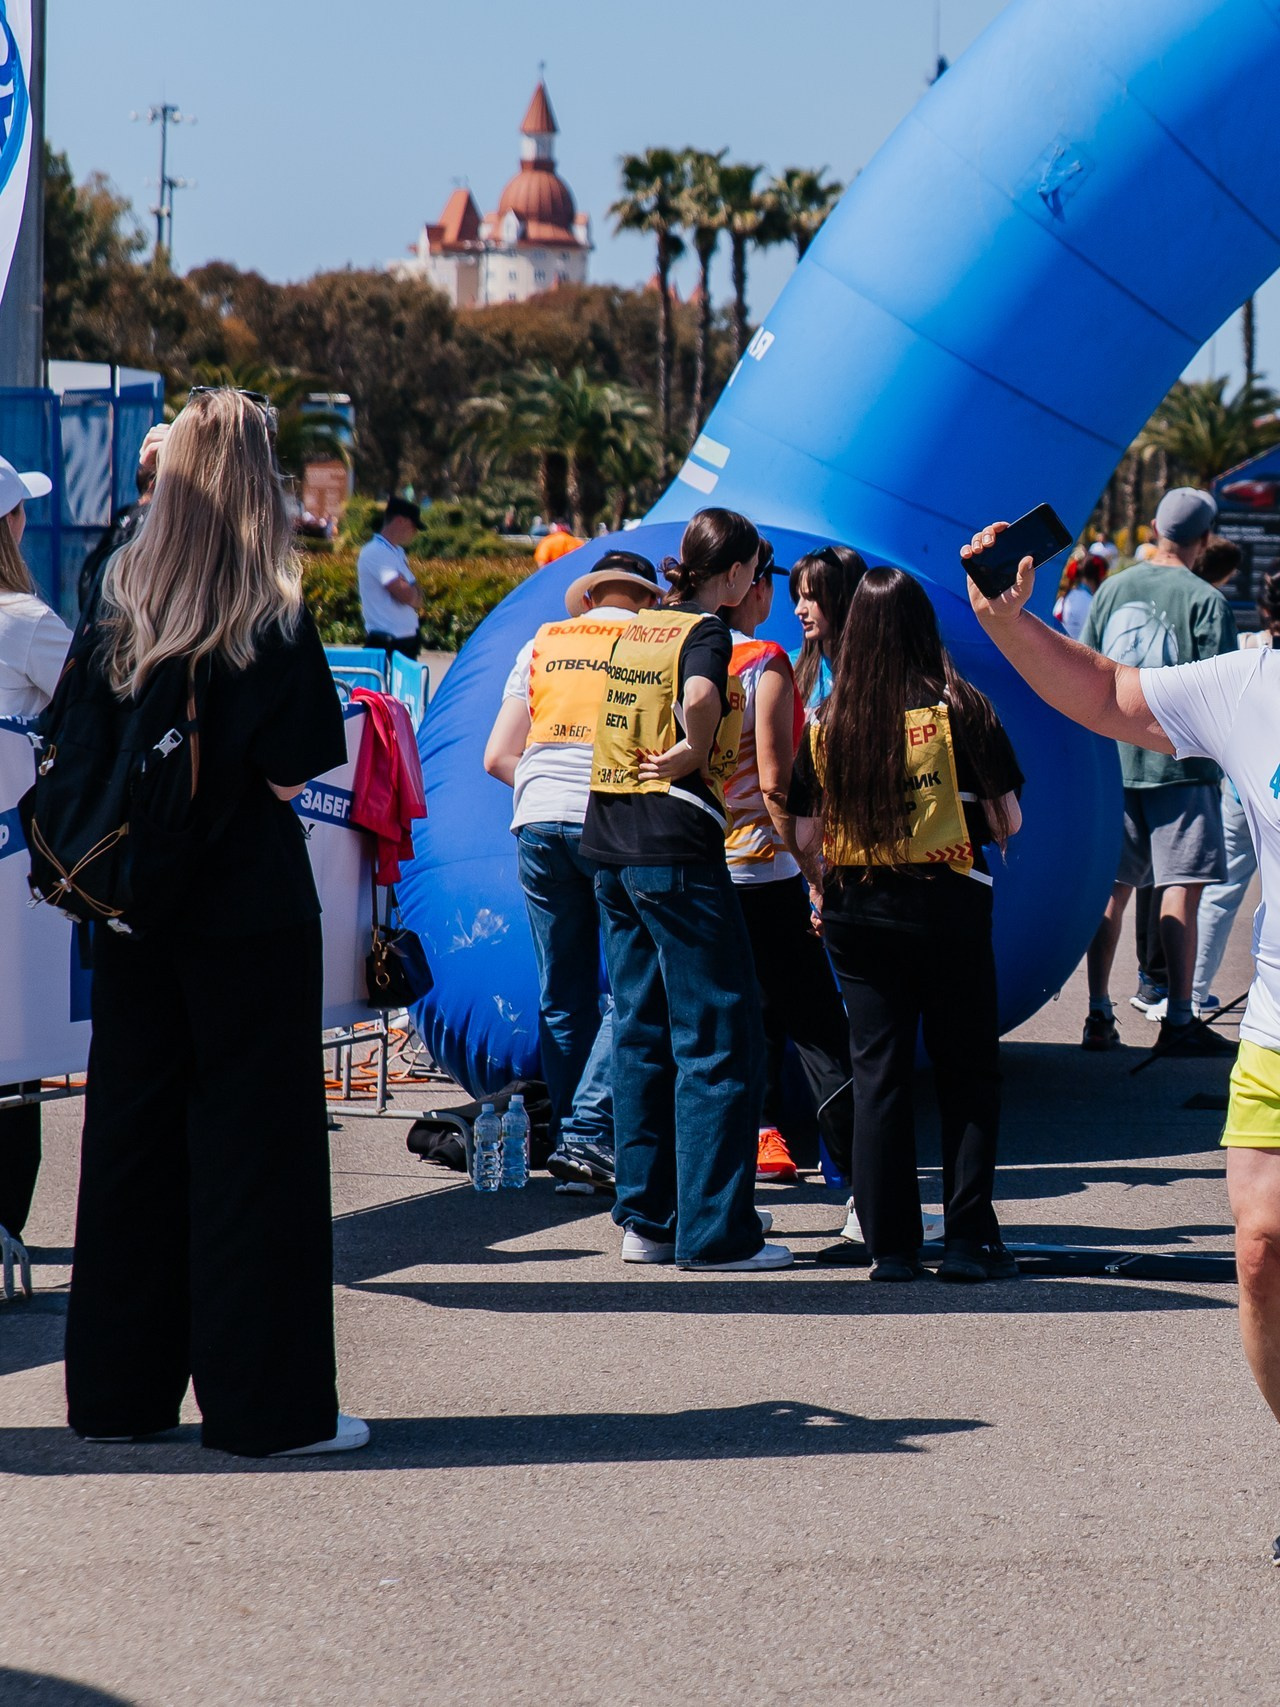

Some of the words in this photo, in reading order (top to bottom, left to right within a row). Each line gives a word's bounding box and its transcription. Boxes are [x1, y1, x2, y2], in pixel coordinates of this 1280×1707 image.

[607, 689, 614, 702] В
[613, 690, 637, 706] МИР
[605, 712, 629, 730] БЕГА
